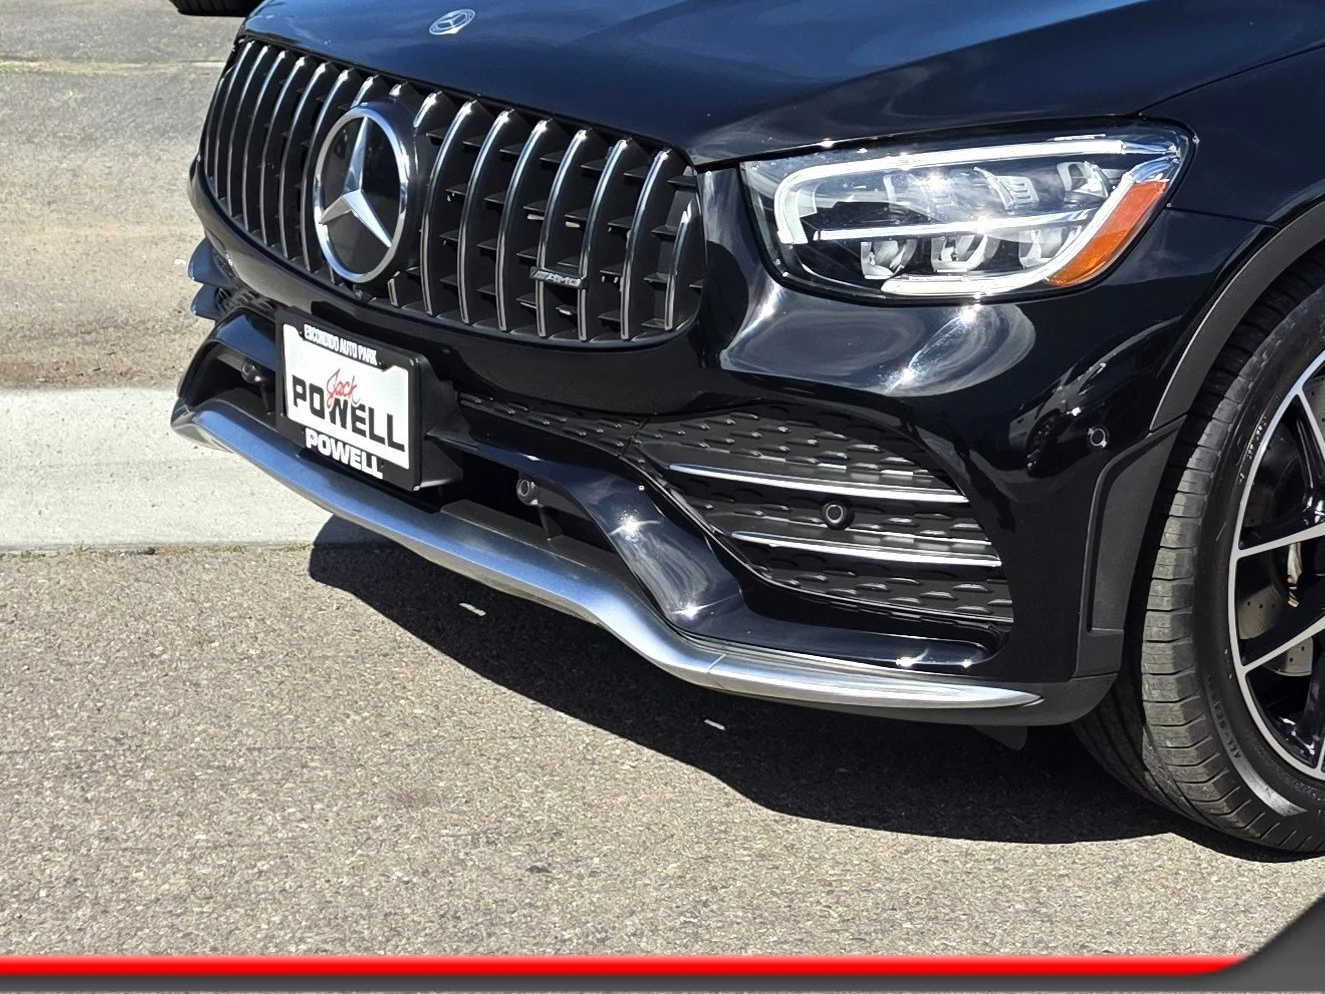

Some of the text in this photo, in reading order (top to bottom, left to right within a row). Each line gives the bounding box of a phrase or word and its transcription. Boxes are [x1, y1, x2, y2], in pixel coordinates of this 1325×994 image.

[357, 344, 378, 366] PARK
[325, 368, 361, 410] Jack
[292, 374, 406, 453] POWELL
[304, 427, 384, 480] POWELL
